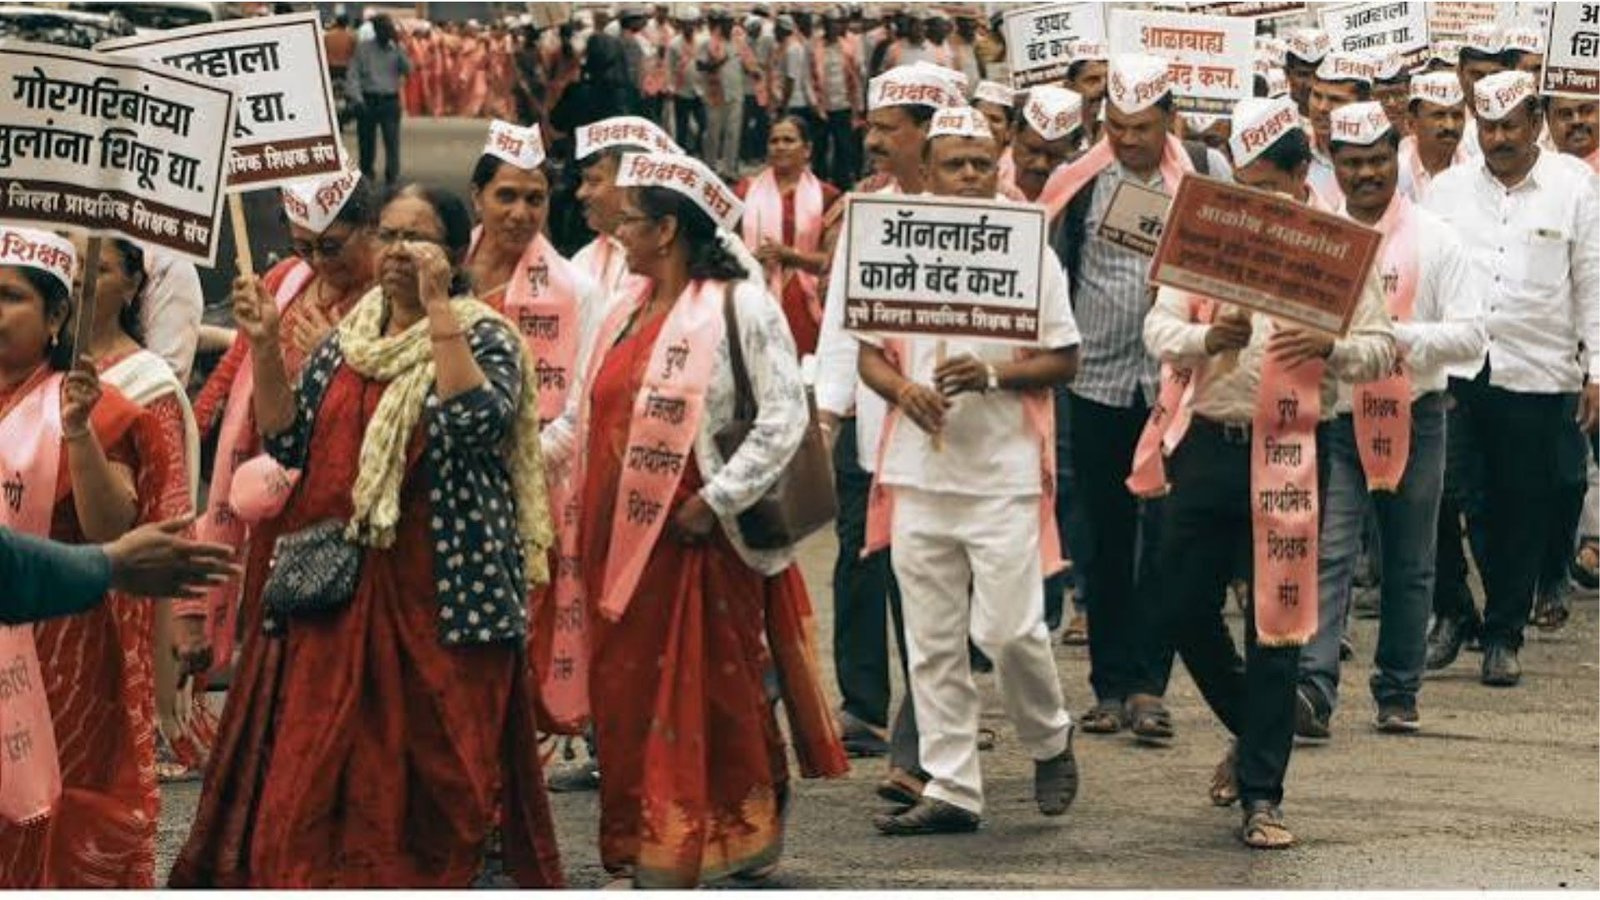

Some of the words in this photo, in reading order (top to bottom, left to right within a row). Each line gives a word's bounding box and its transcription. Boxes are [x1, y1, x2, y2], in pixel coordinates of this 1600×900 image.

[13, 66, 194, 137] गोरगरिबांच्या
[246, 93, 296, 124] द्या.
[168, 150, 204, 193] द्या.
[311, 142, 336, 164] संघ
[183, 218, 210, 246] संघ
[881, 209, 1013, 255] ऑनलाईन
[859, 254, 919, 291] कामे
[924, 256, 962, 293] बंद
[966, 266, 1024, 299] करा.
